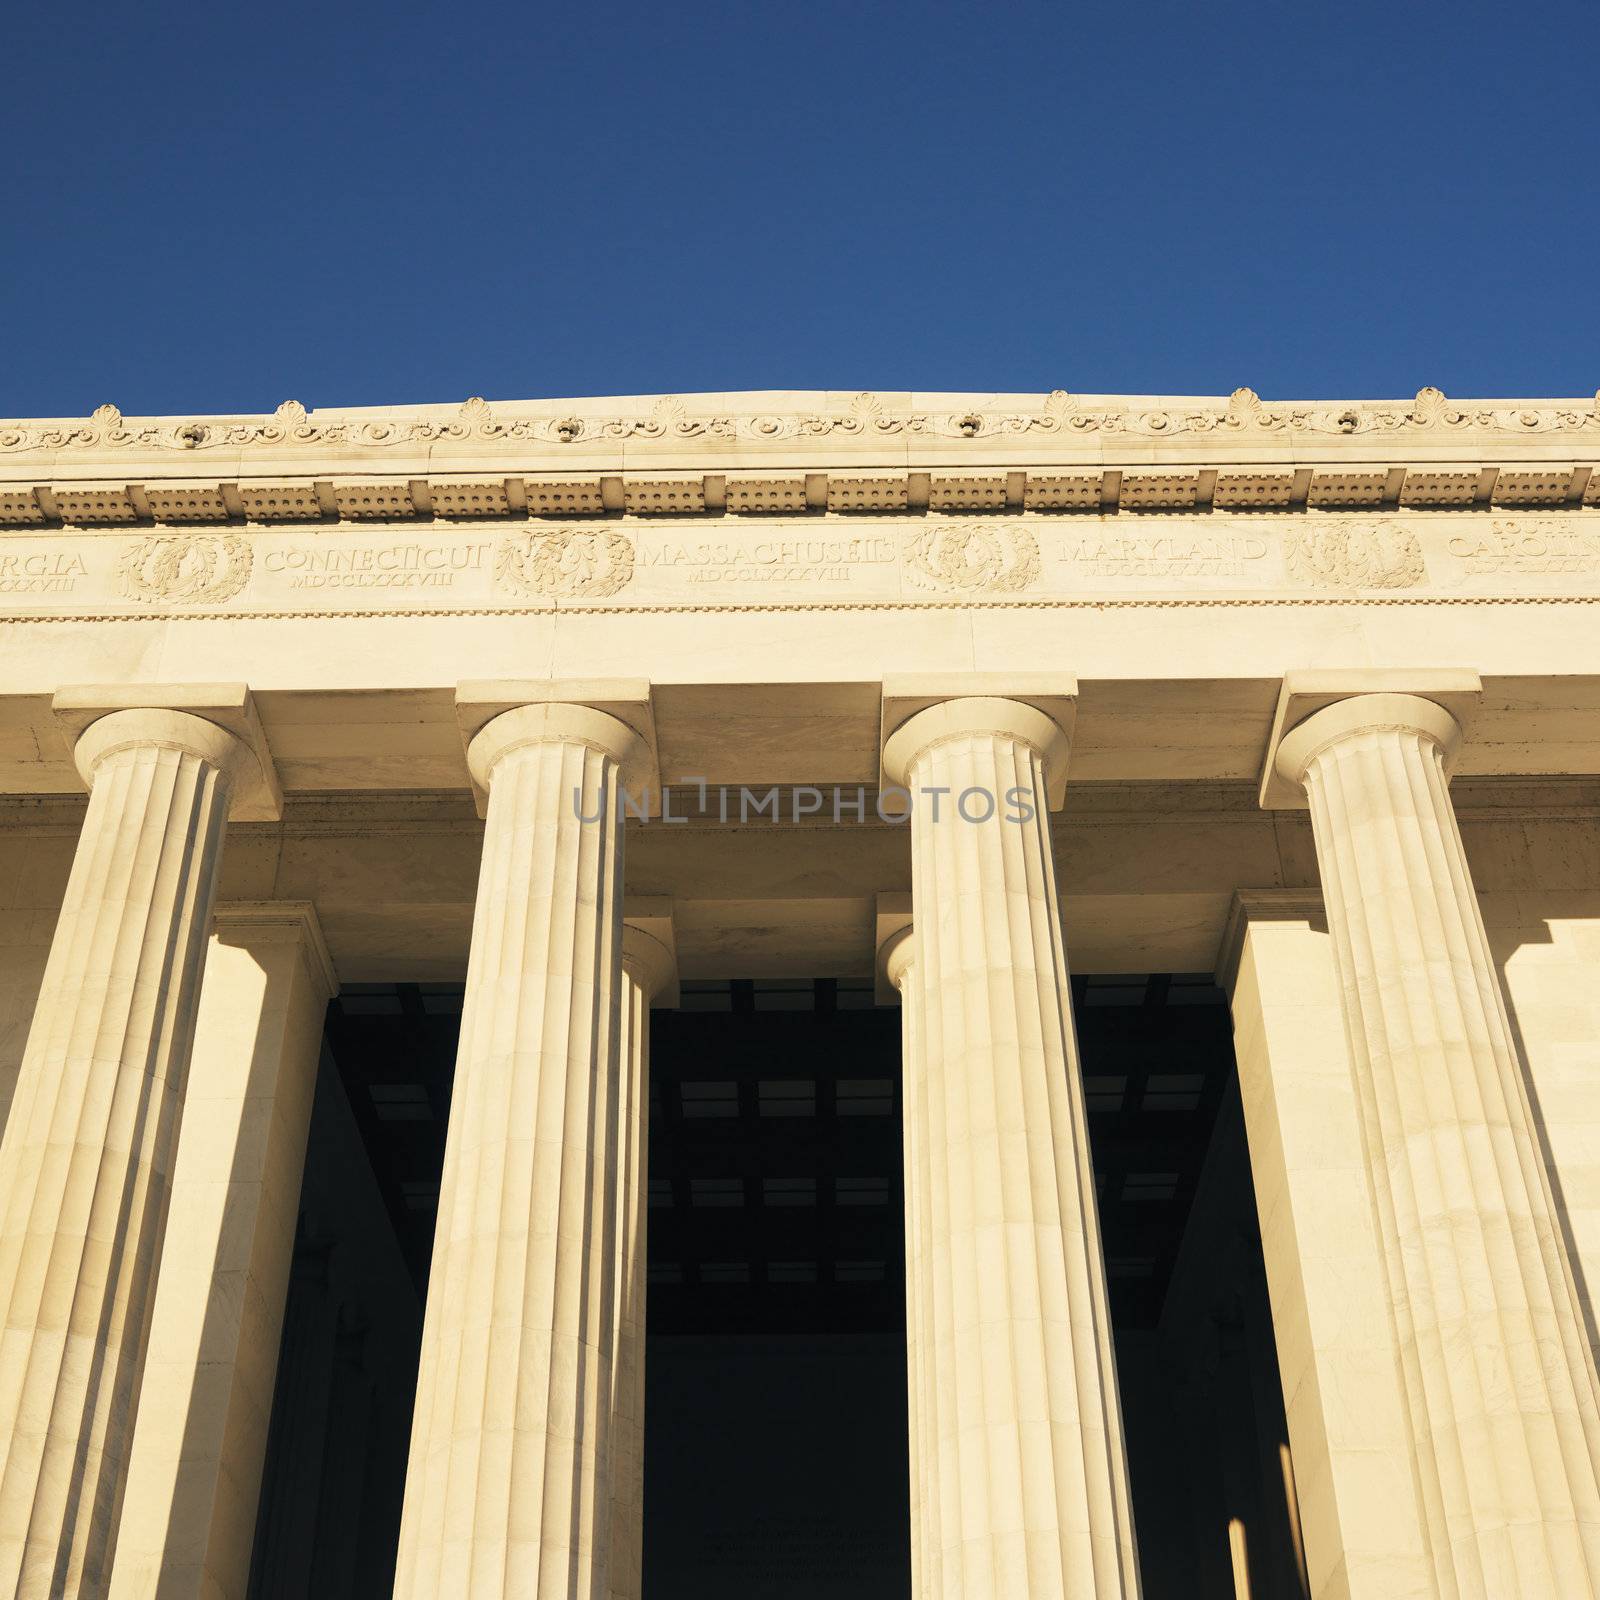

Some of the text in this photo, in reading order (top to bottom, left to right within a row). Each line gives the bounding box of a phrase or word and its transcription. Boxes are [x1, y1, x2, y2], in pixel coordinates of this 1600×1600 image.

[264, 542, 491, 571] CONNECTICUT
[636, 537, 895, 567] MASSACHUSETTS
[1056, 538, 1267, 561] MARYLAND
[290, 572, 454, 588] MDCCLXXXVIII
[686, 567, 850, 583] MDCCLXXXVIII
